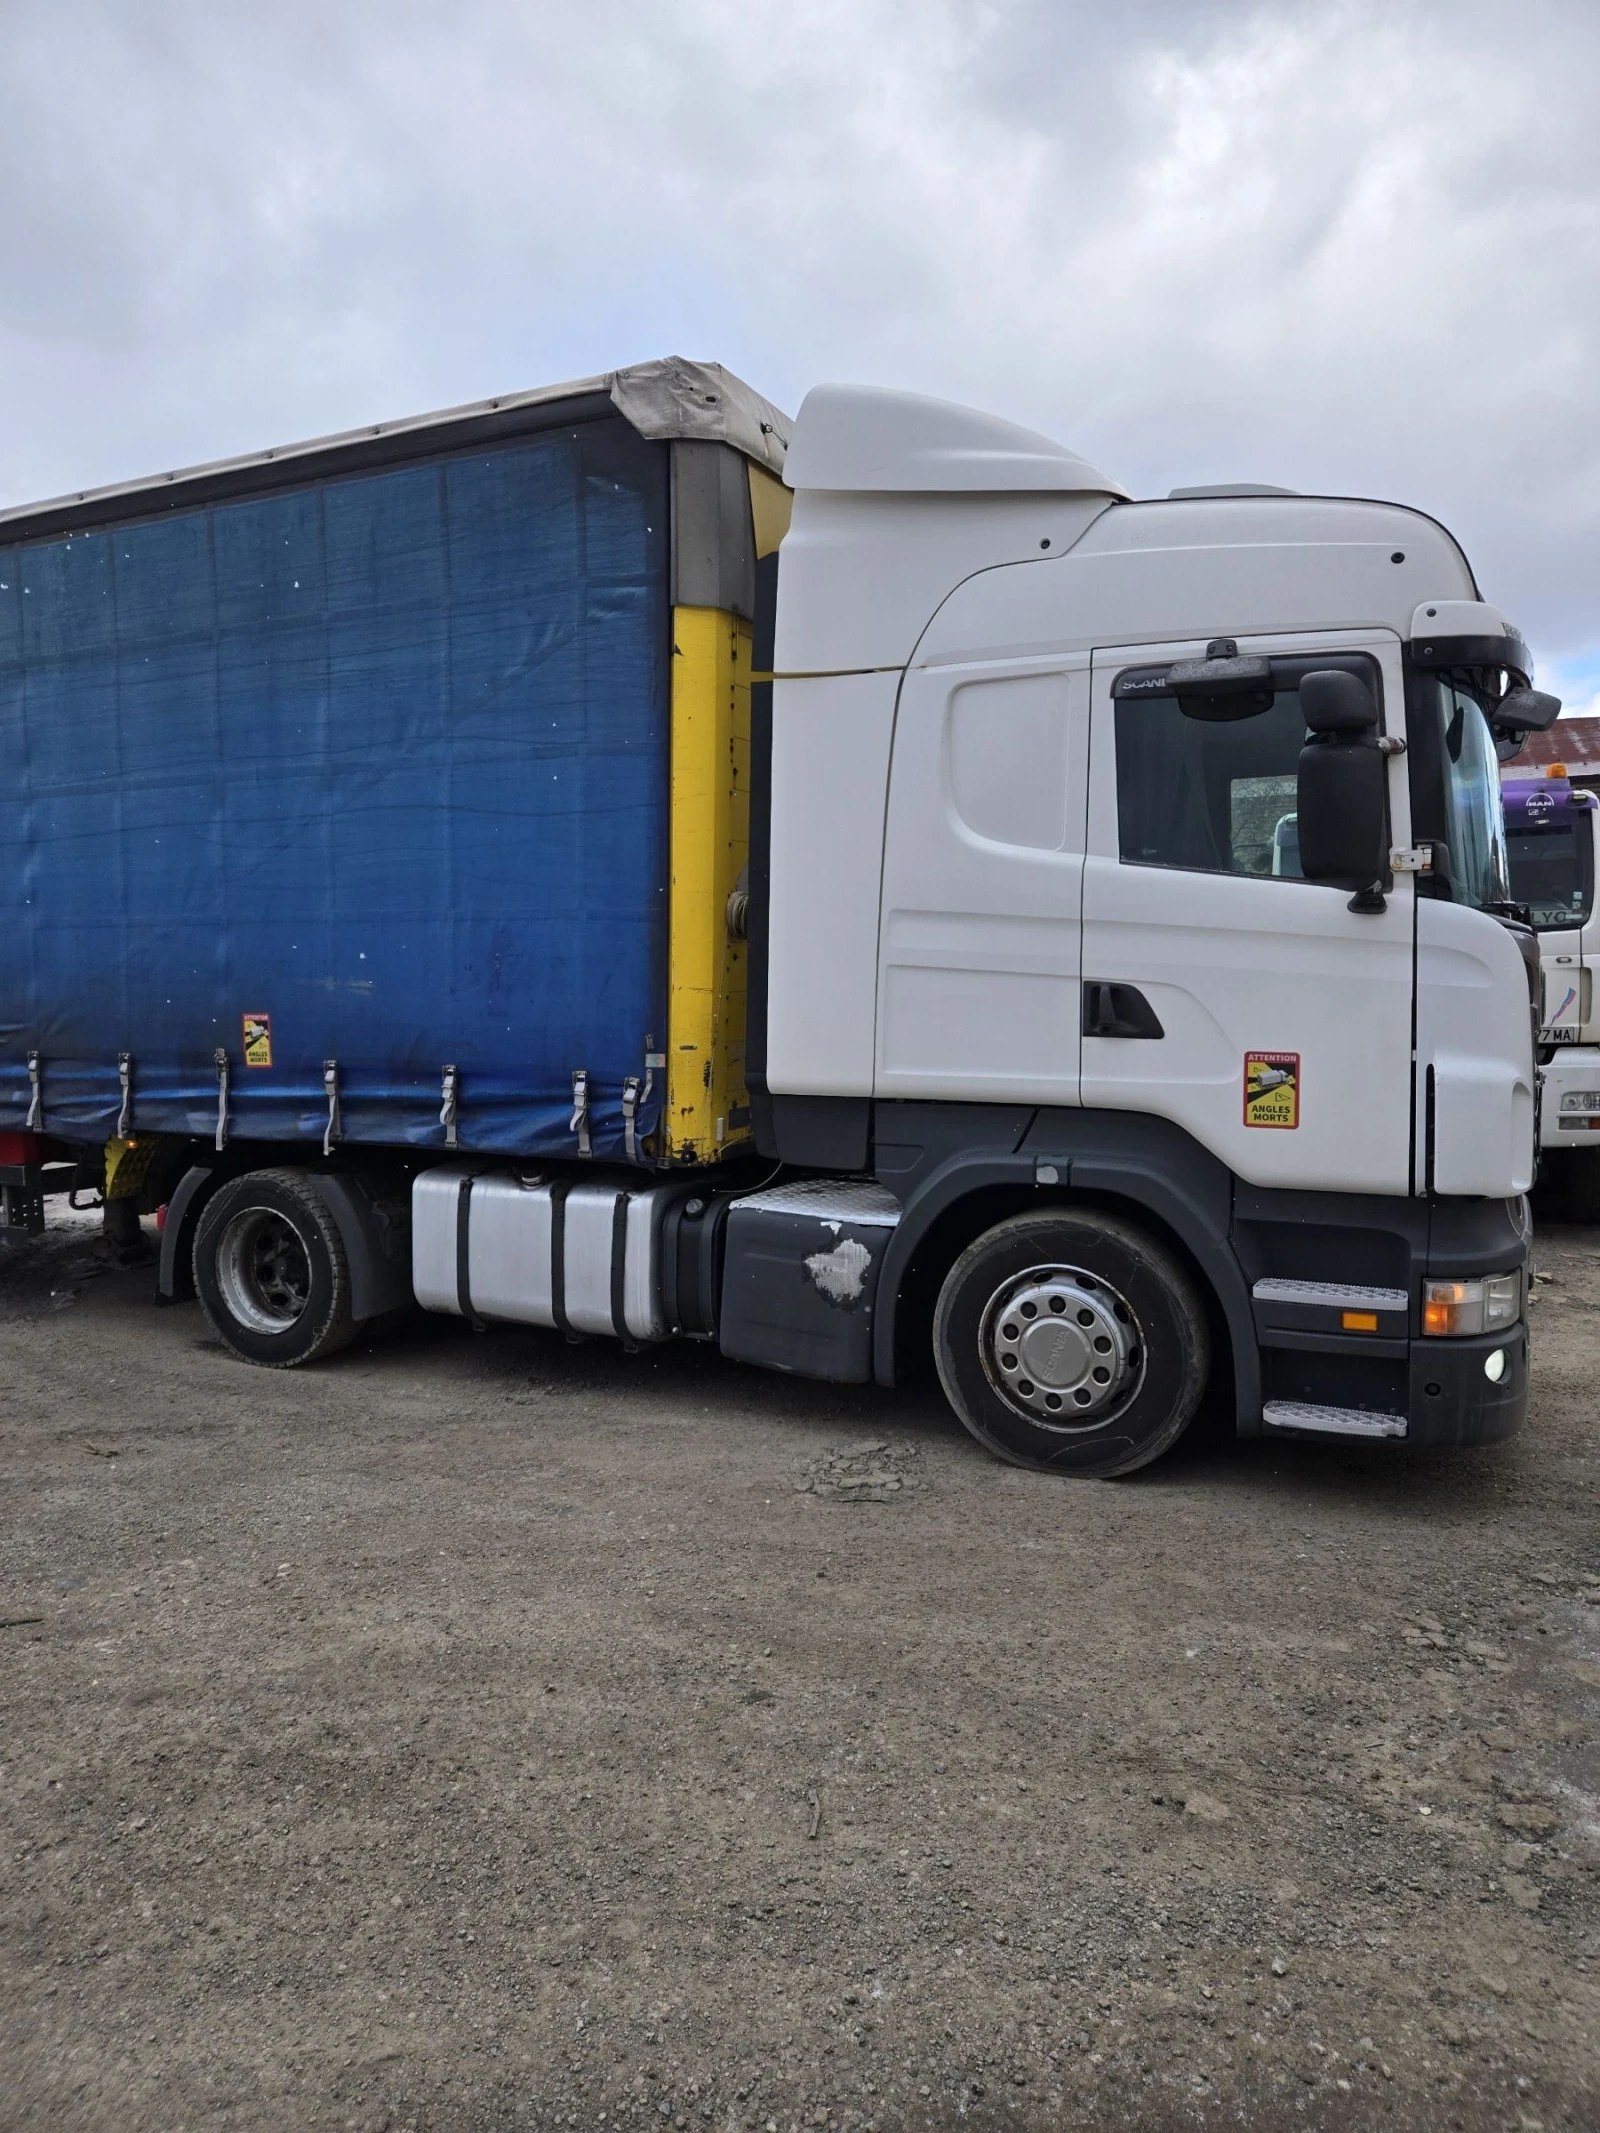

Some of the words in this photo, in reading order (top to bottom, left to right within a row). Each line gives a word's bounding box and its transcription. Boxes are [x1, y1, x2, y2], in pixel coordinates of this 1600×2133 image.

[1122, 678, 1166, 690] SCANI
[1553, 1029, 1571, 1042] MA
[1248, 1054, 1297, 1062] ATTENTION
[1251, 1104, 1291, 1114] ANGLES
[1253, 1113, 1289, 1122] MORTS
